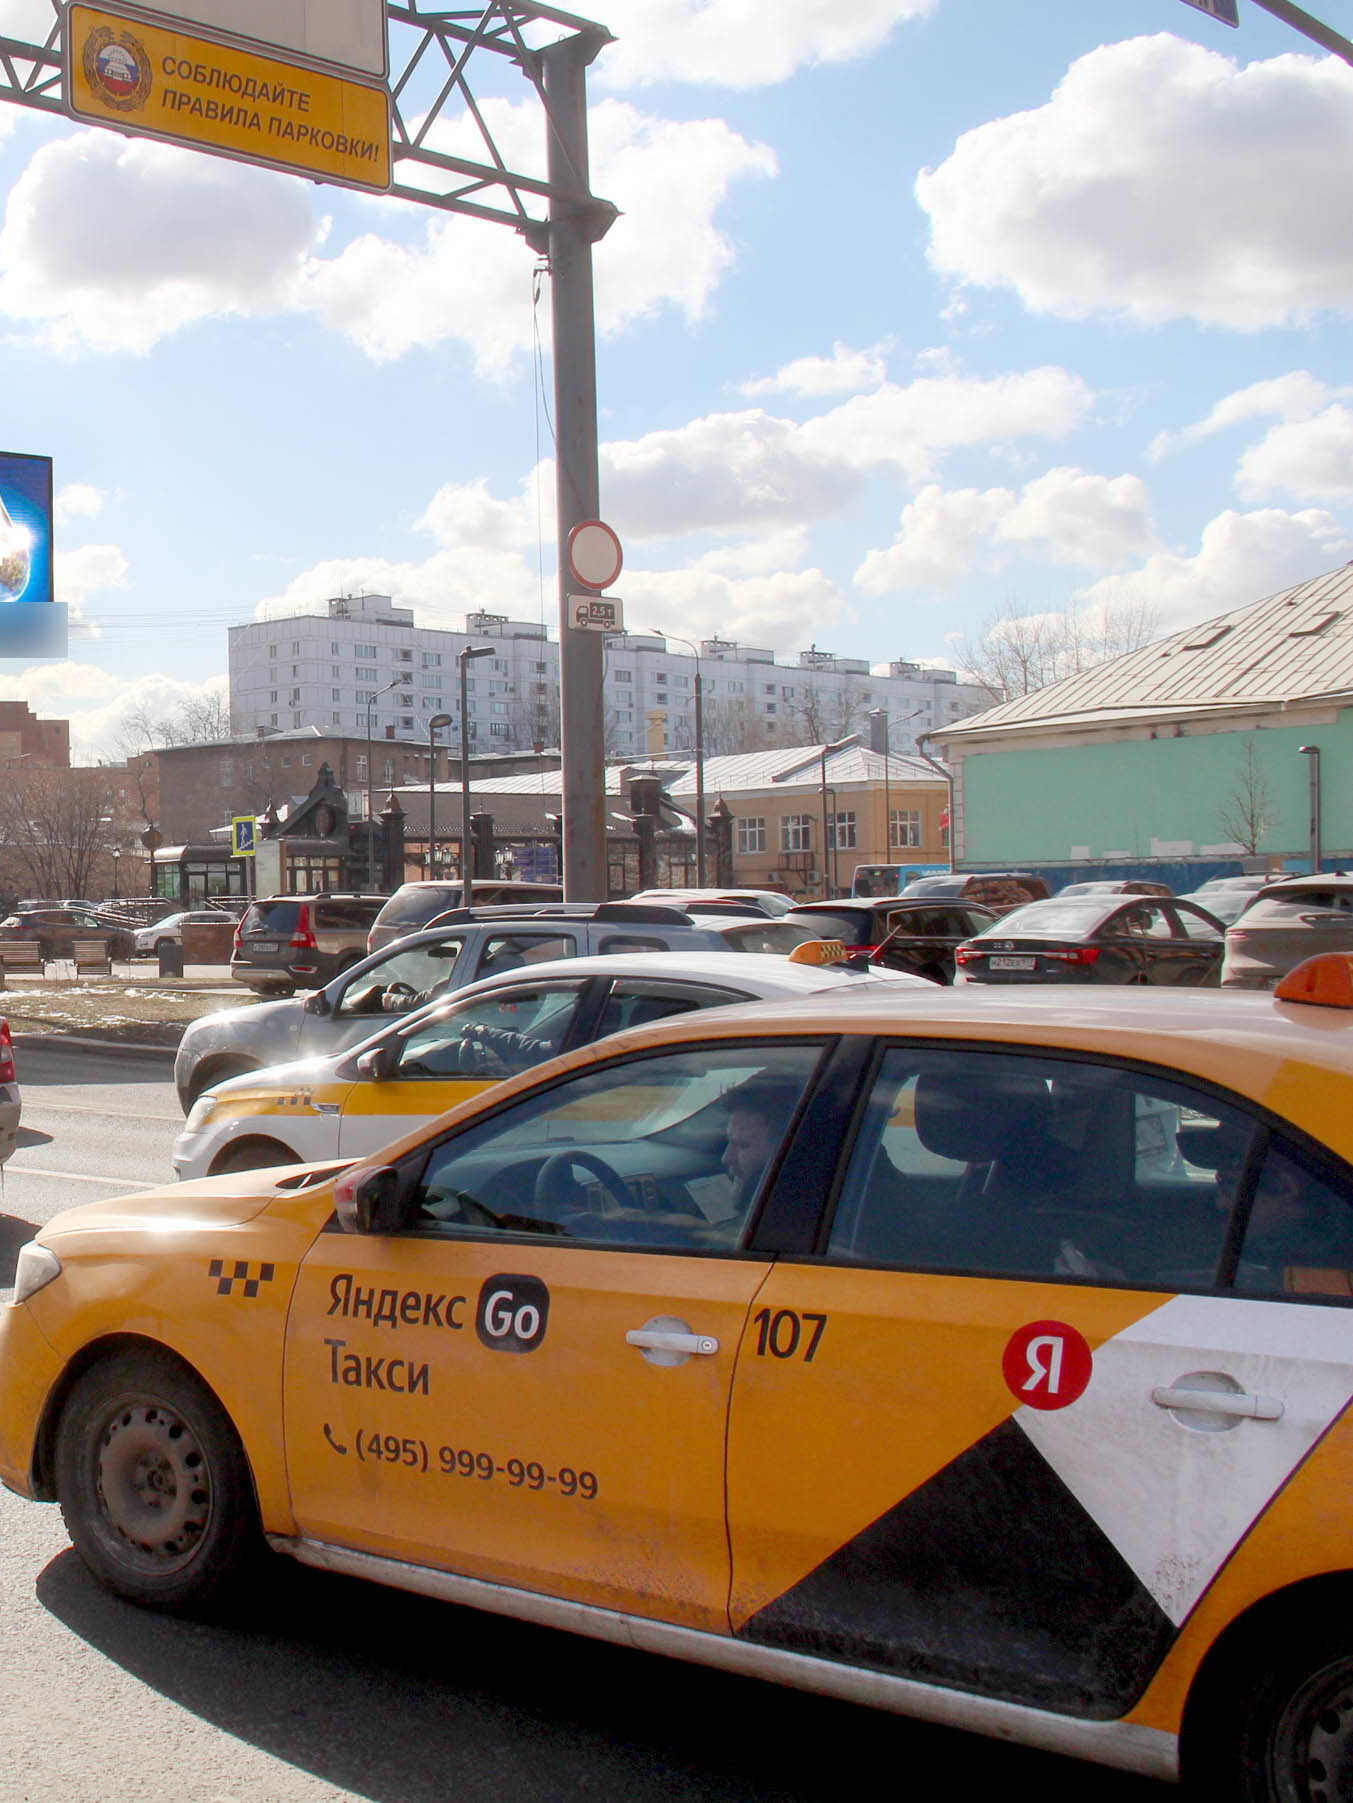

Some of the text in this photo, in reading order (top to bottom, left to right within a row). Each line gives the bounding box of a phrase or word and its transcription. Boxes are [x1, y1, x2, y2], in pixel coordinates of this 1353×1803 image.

[161, 55, 311, 112] СОБЛЮДАЙТЕ
[161, 89, 381, 163] ПРАВИЛА ПАРКОВКИ!
[327, 1273, 542, 1340] Яндекс Go
[754, 1308, 828, 1362] 107
[324, 1337, 430, 1396] Такси
[1021, 1335, 1064, 1394] Я
[355, 1428, 599, 1500] (495) 999-99-99
